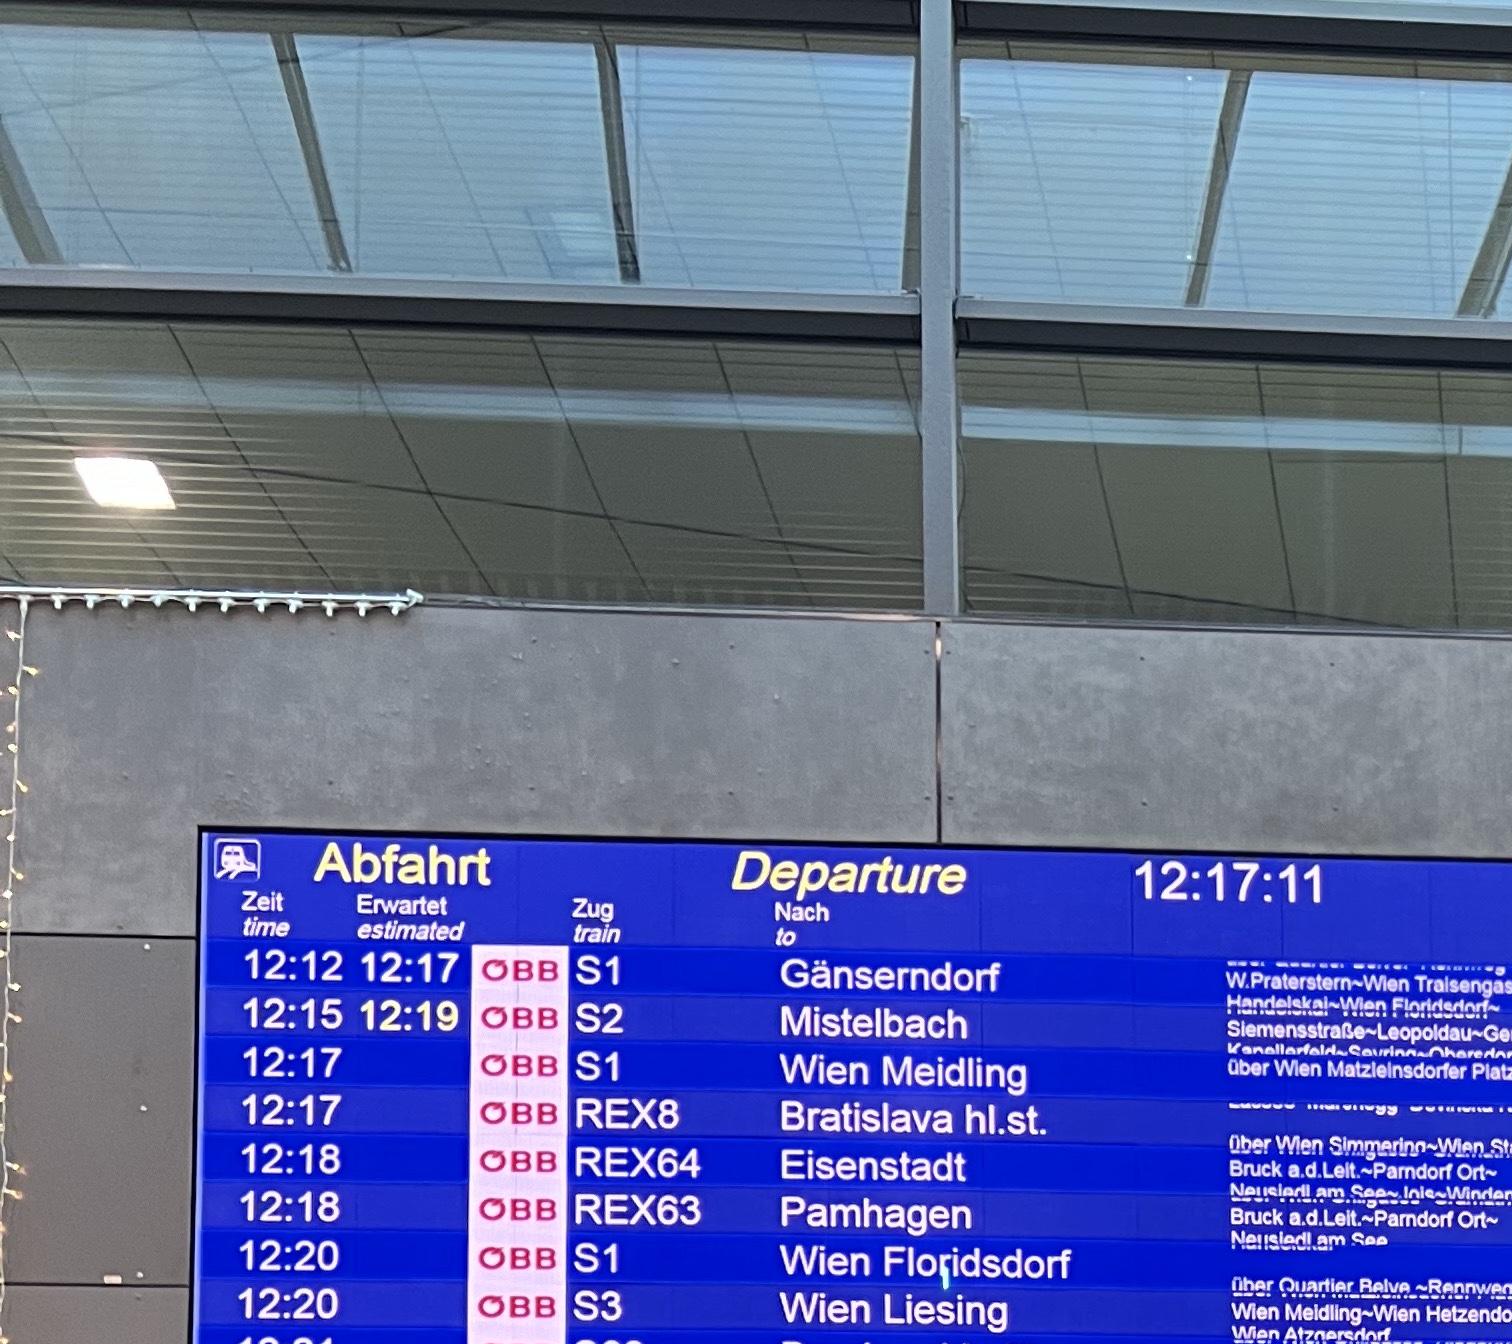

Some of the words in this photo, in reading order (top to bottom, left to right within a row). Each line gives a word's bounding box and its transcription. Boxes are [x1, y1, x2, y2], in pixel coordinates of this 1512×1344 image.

[314, 842, 491, 886] Abfahrt
[732, 851, 967, 901] Departure
[1136, 861, 1320, 903] 12:17:11
[242, 891, 283, 911] Zeit
[357, 894, 447, 915] Erwartet
[572, 898, 614, 923] Zug
[775, 902, 829, 921] Nach
[243, 917, 290, 937] time
[358, 920, 465, 940] estimated
[574, 924, 621, 943] train
[776, 928, 796, 946] to
[245, 949, 342, 980] 12:12
[362, 952, 459, 982] 12:17
[576, 955, 618, 985] S1
[781, 959, 1001, 992] Gänserndorf
[244, 997, 343, 1029] 12:15
[361, 1000, 458, 1031] 12:19
[576, 1003, 623, 1033] S2
[781, 1006, 968, 1039] Mistelbach
[244, 1047, 342, 1077] 12:17
[576, 1051, 618, 1081] S1
[780, 1054, 868, 1085] Wien
[883, 1056, 1026, 1096] Meidling
[1275, 1060, 1321, 1078] Wien
[243, 1094, 341, 1125] 12:17
[576, 1098, 679, 1129] REX8
[782, 1101, 953, 1133] Bratislava
[966, 1104, 1046, 1135] hl.st.
[242, 1143, 340, 1174] 12:18
[576, 1147, 700, 1178] REX64
[782, 1150, 966, 1182] Eisenstadt
[241, 1191, 340, 1222] 12:18
[575, 1194, 701, 1225] REX63
[782, 1196, 972, 1236] Pamhagen
[240, 1240, 338, 1270] 12:20
[574, 1243, 617, 1273] S1
[780, 1245, 870, 1276] Wien
[885, 1246, 1072, 1278] Floridsdorf
[239, 1288, 338, 1319] 12:20
[574, 1290, 622, 1321] S3
[780, 1292, 870, 1323] Wien
[885, 1294, 1008, 1333] Liesing
